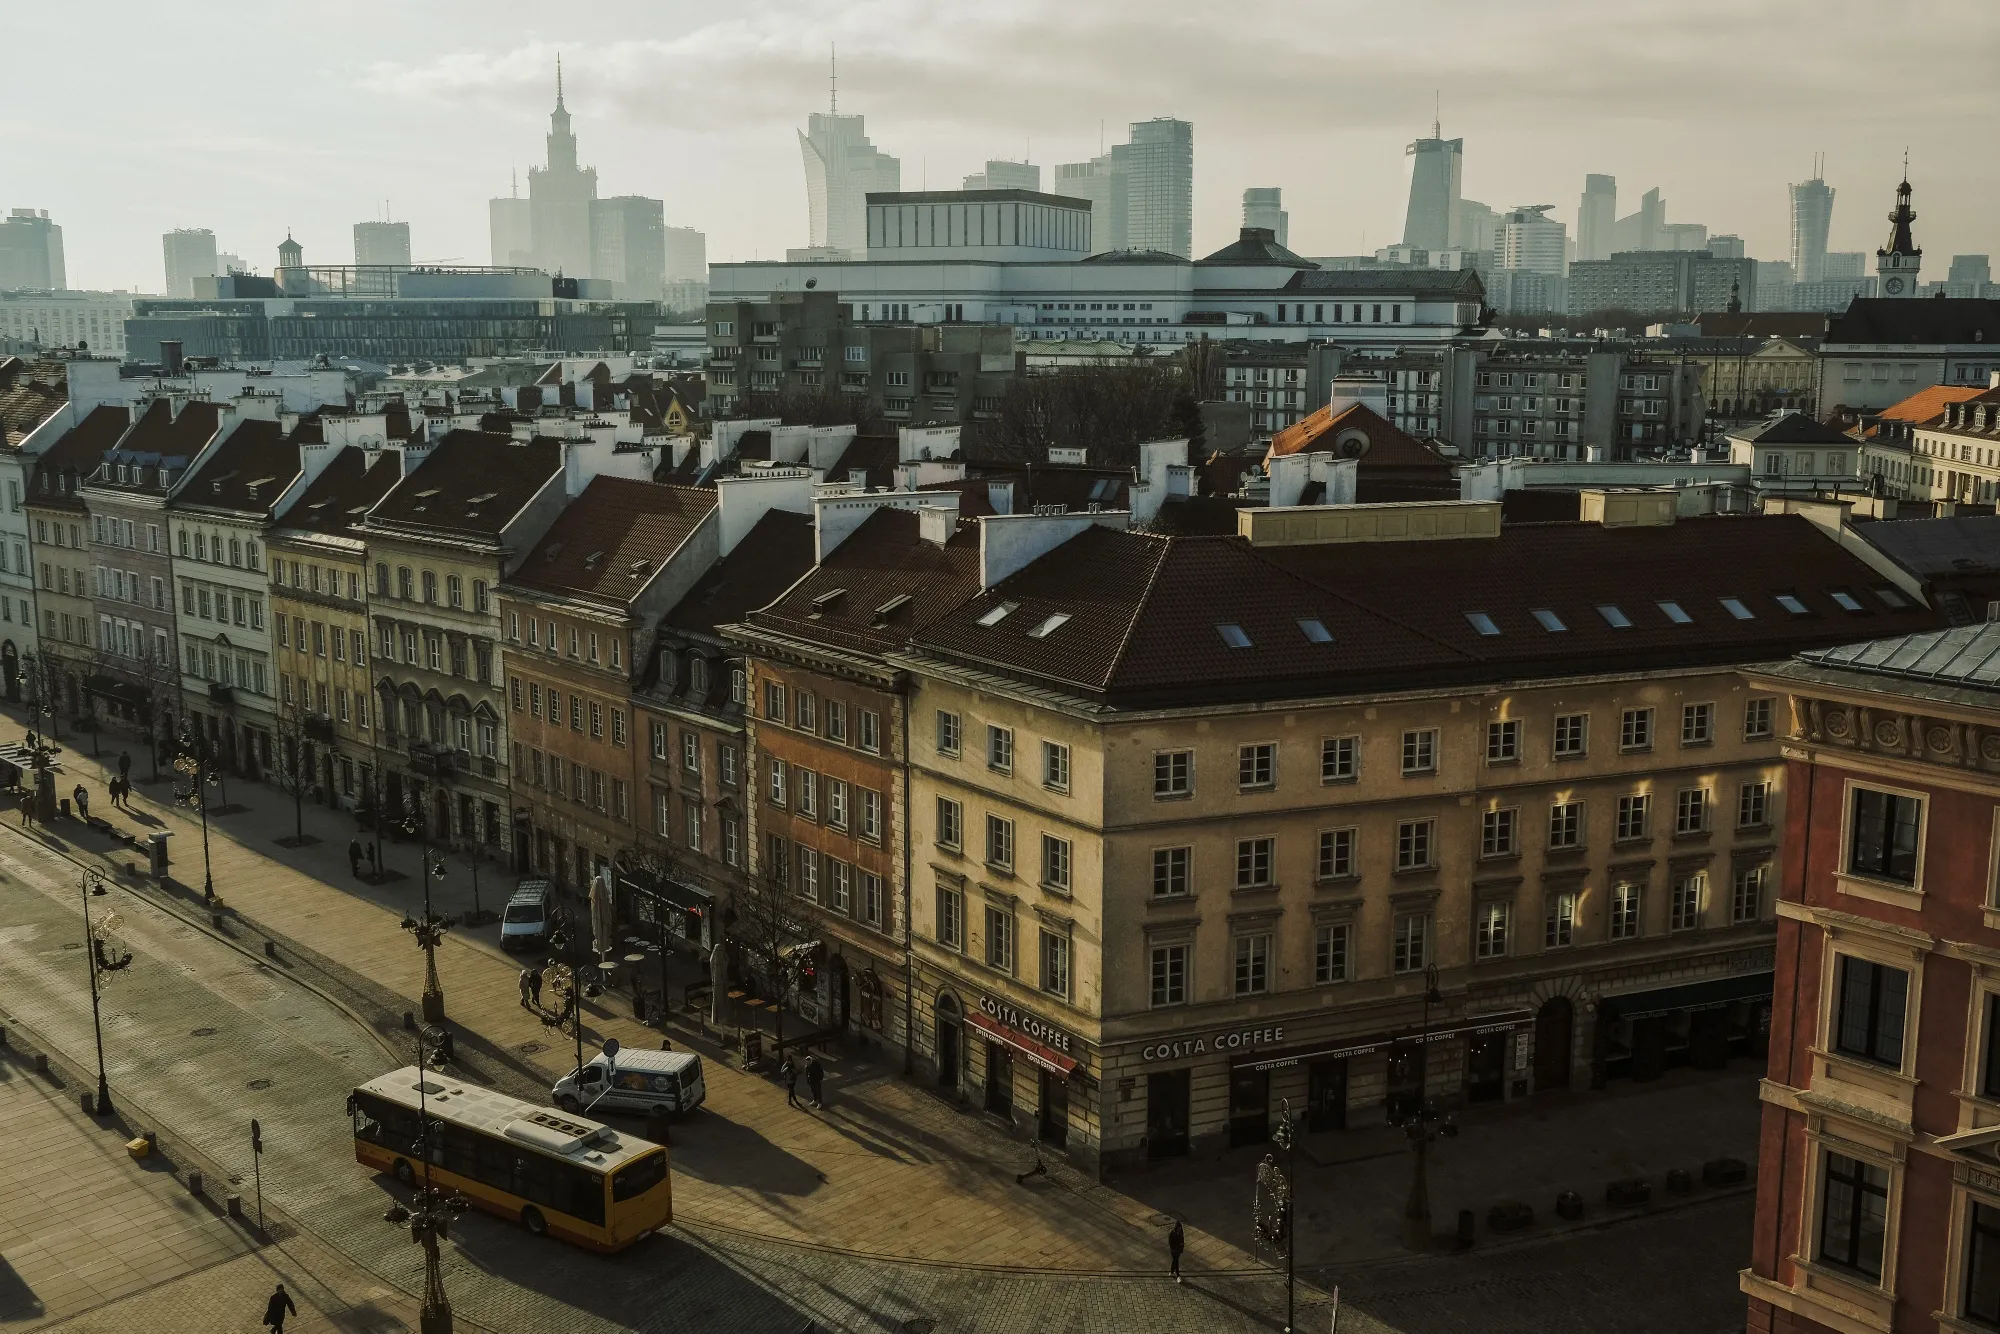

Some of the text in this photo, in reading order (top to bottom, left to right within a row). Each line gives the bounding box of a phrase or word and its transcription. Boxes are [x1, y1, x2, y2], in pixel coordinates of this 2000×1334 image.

[980, 996, 1069, 1051] COSTA COFFEE
[1476, 1024, 1516, 1035] COSTA COFFEE
[1142, 1026, 1284, 1060] COSTA COFFEE
[1415, 1032, 1455, 1044] COTA COFFEE
[1333, 1046, 1376, 1059] COSTA COFFEE
[1027, 1054, 1056, 1073] COSTA COFFEE
[1255, 1059, 1298, 1071] COSTA COFFEE
